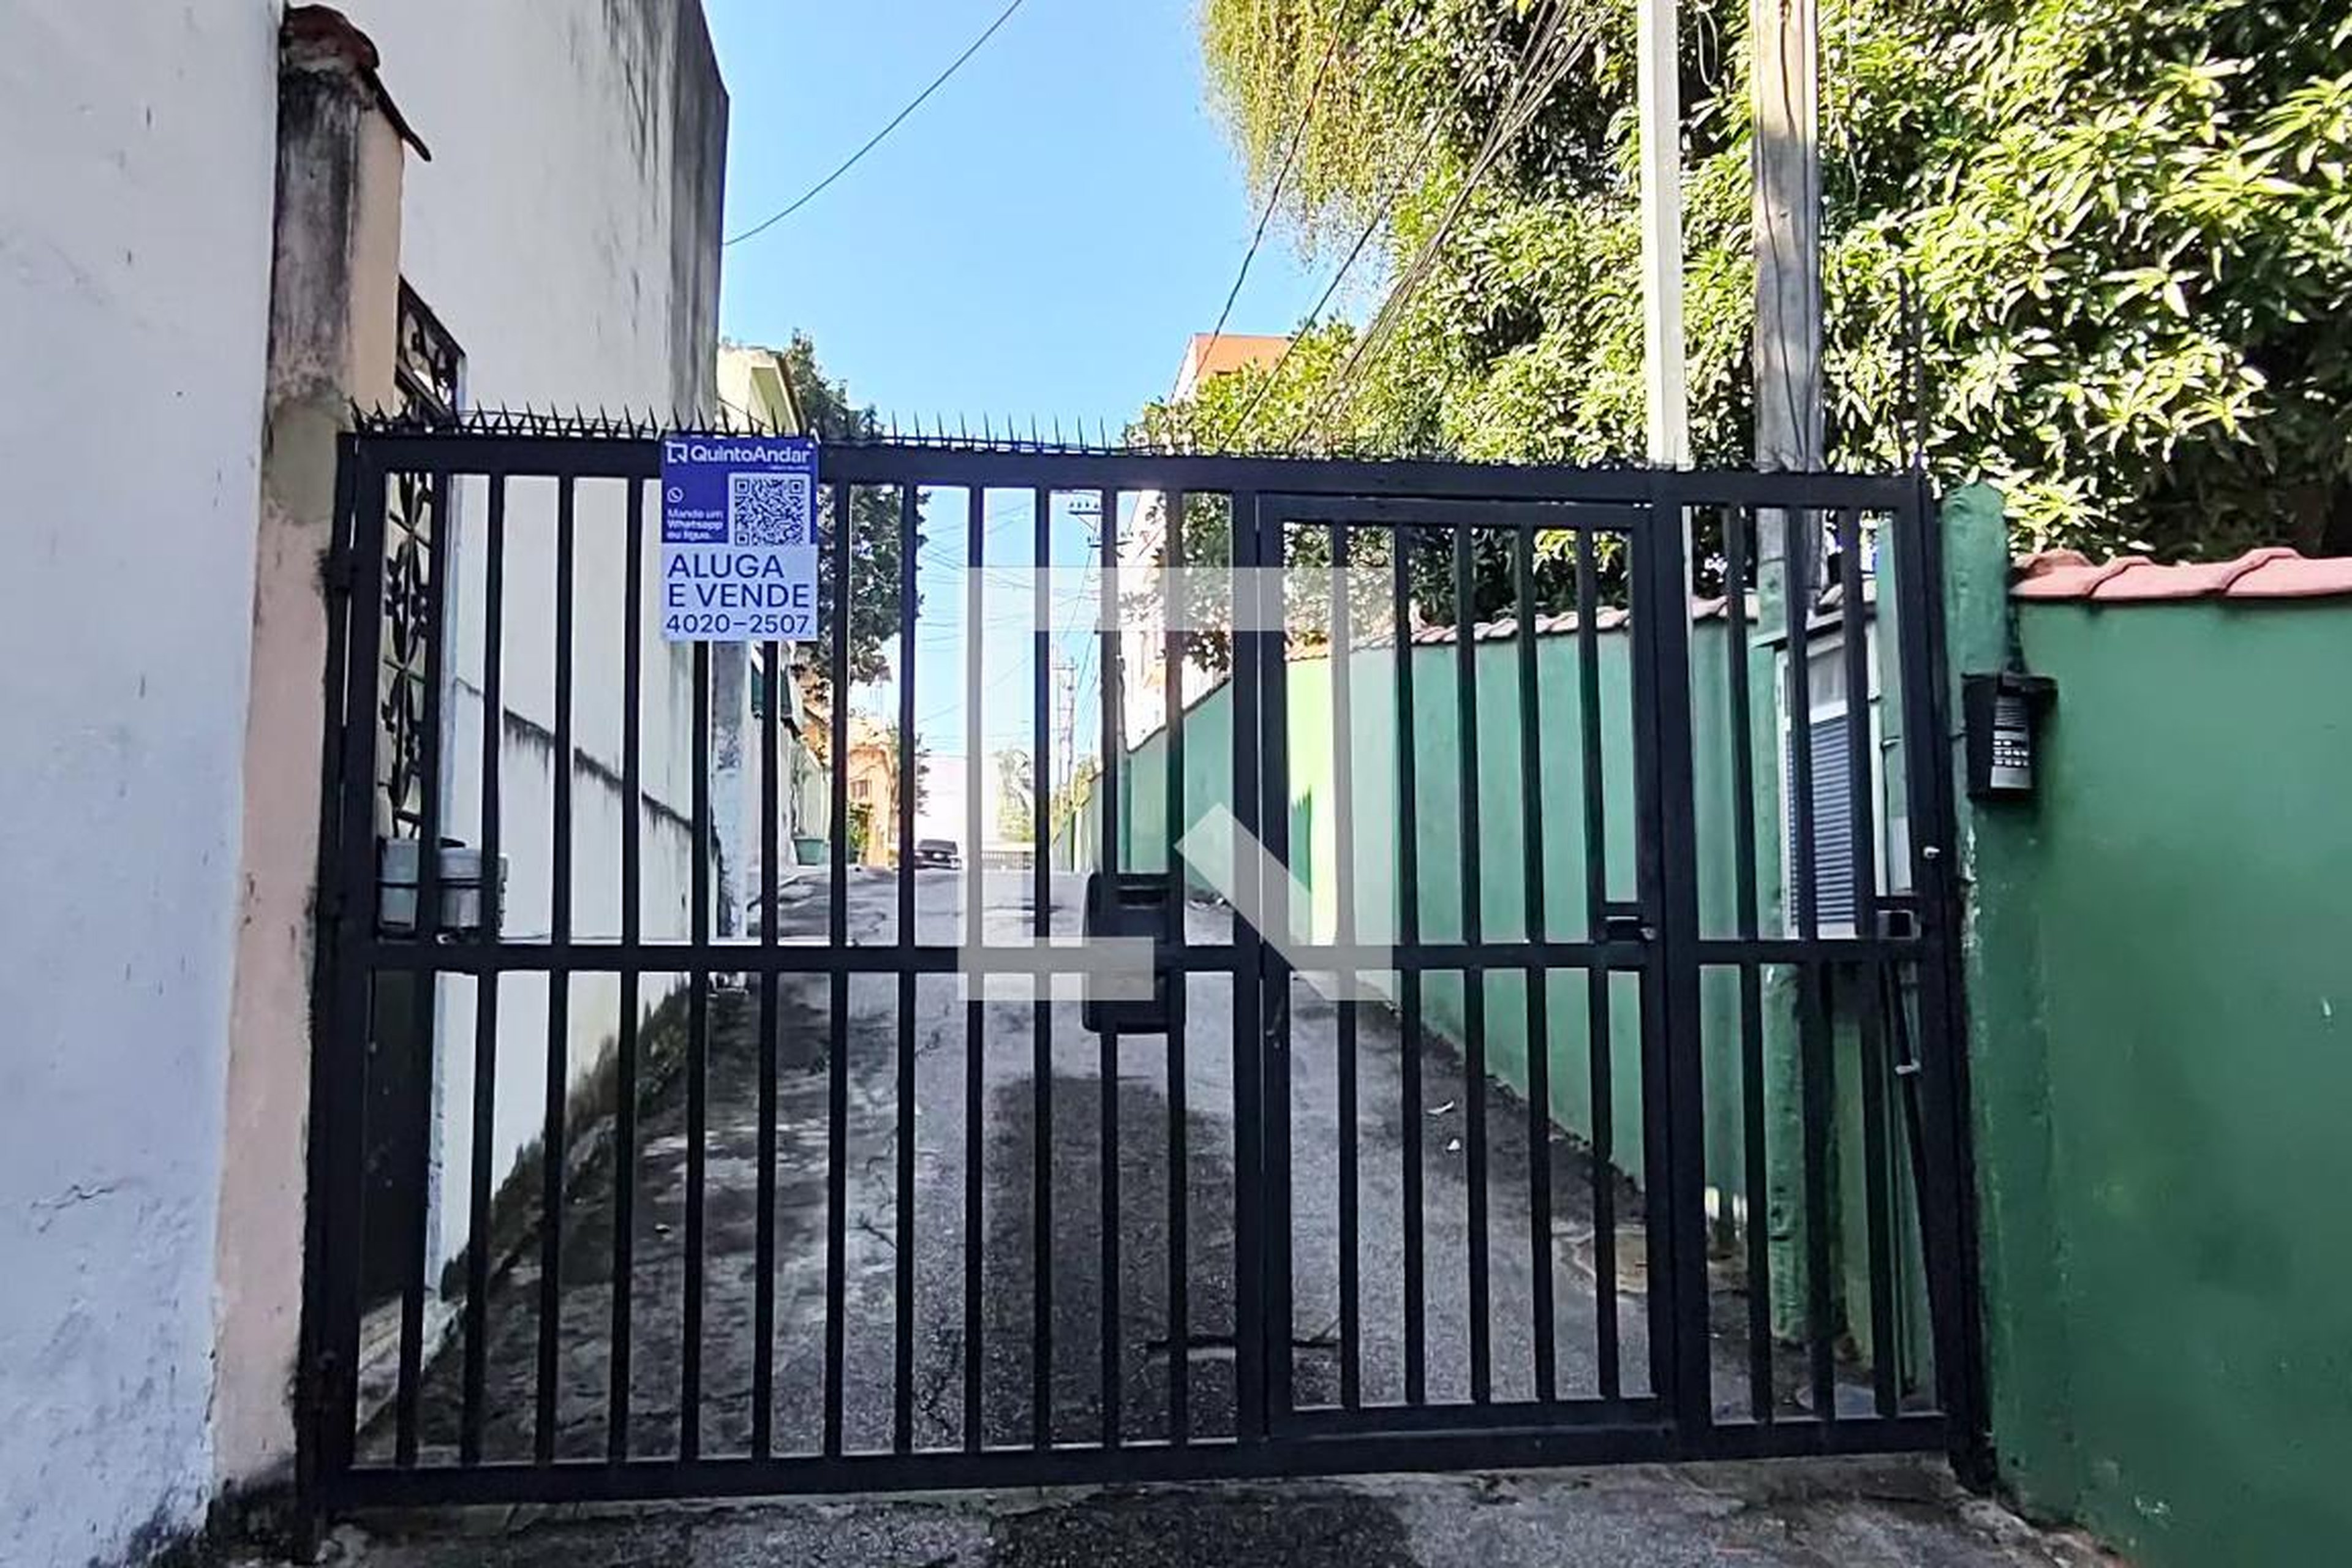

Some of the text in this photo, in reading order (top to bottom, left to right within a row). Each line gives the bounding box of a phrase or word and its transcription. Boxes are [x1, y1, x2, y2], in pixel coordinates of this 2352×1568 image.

[691, 445, 810, 462] QuintoAndar
[668, 554, 785, 579] ALUGA
[669, 583, 809, 608] E VENDE
[666, 614, 809, 635] 4020-2507
